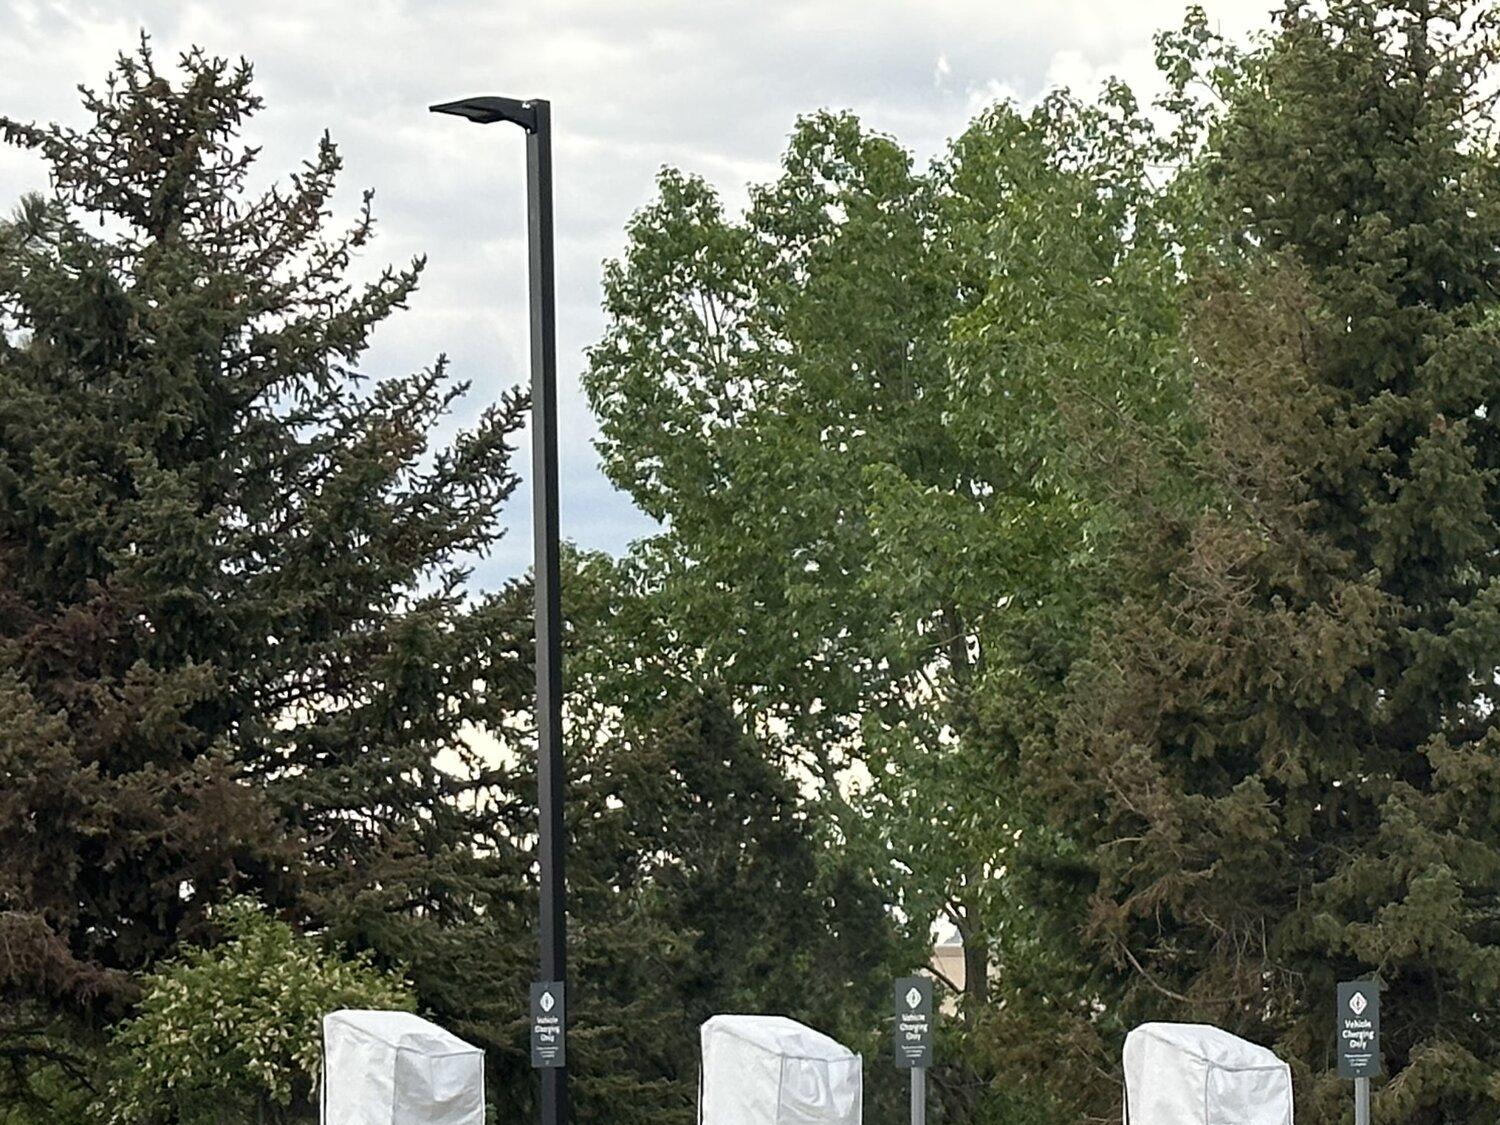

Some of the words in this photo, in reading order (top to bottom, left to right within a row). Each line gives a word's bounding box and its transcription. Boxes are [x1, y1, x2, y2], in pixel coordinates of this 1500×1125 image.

[1344, 1019, 1372, 1029] Vehicle
[1342, 1029, 1375, 1040] Charging
[1349, 1039, 1367, 1050] Only
